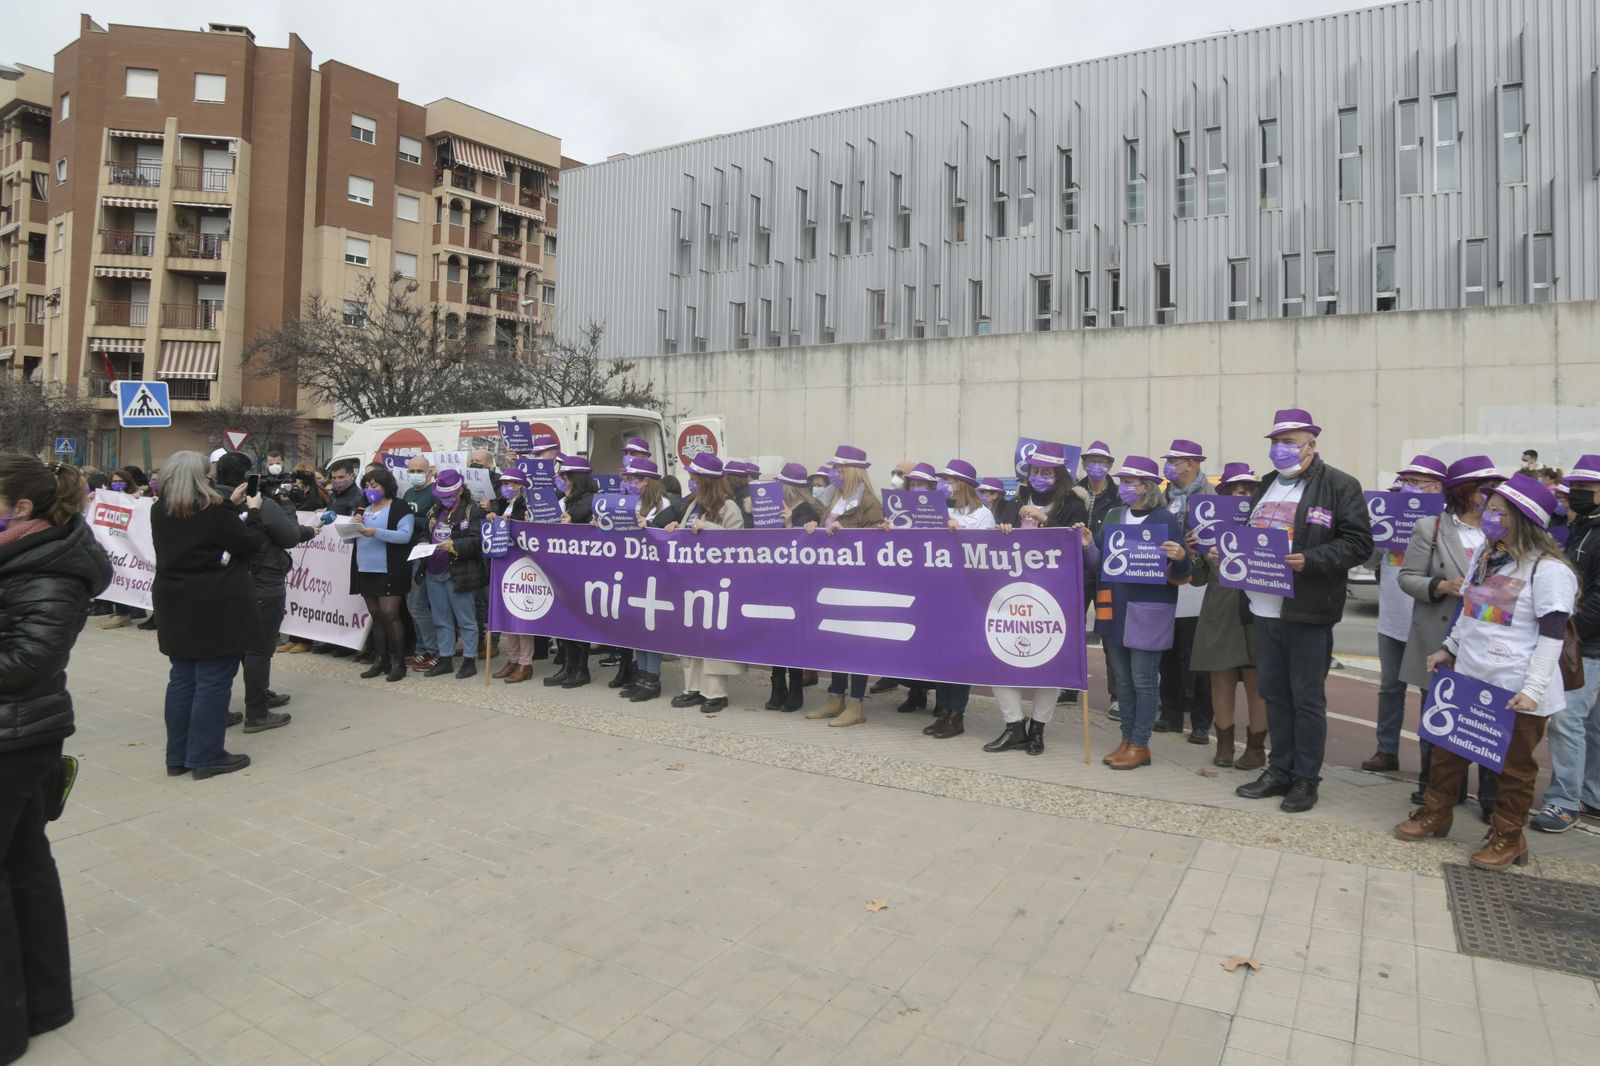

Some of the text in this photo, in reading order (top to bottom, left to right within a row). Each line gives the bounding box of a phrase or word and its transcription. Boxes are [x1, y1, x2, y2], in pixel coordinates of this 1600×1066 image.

[517, 530, 1062, 577] de marzo Día Internacional de la Mujer
[1247, 559, 1285, 570] feministas
[521, 572, 537, 582] UGT
[1125, 569, 1165, 577] sindicalista
[131, 579, 152, 594] soci
[503, 582, 553, 597] FEMINISTA
[1246, 577, 1291, 590] sindicalista
[290, 601, 349, 628] Preparada.
[1009, 604, 1034, 617] UGT
[987, 618, 1064, 634] FEMINISTA
[1469, 706, 1496, 721] Mujeres
[1457, 714, 1502, 737] feministas
[1447, 735, 1502, 763] sindicalista
